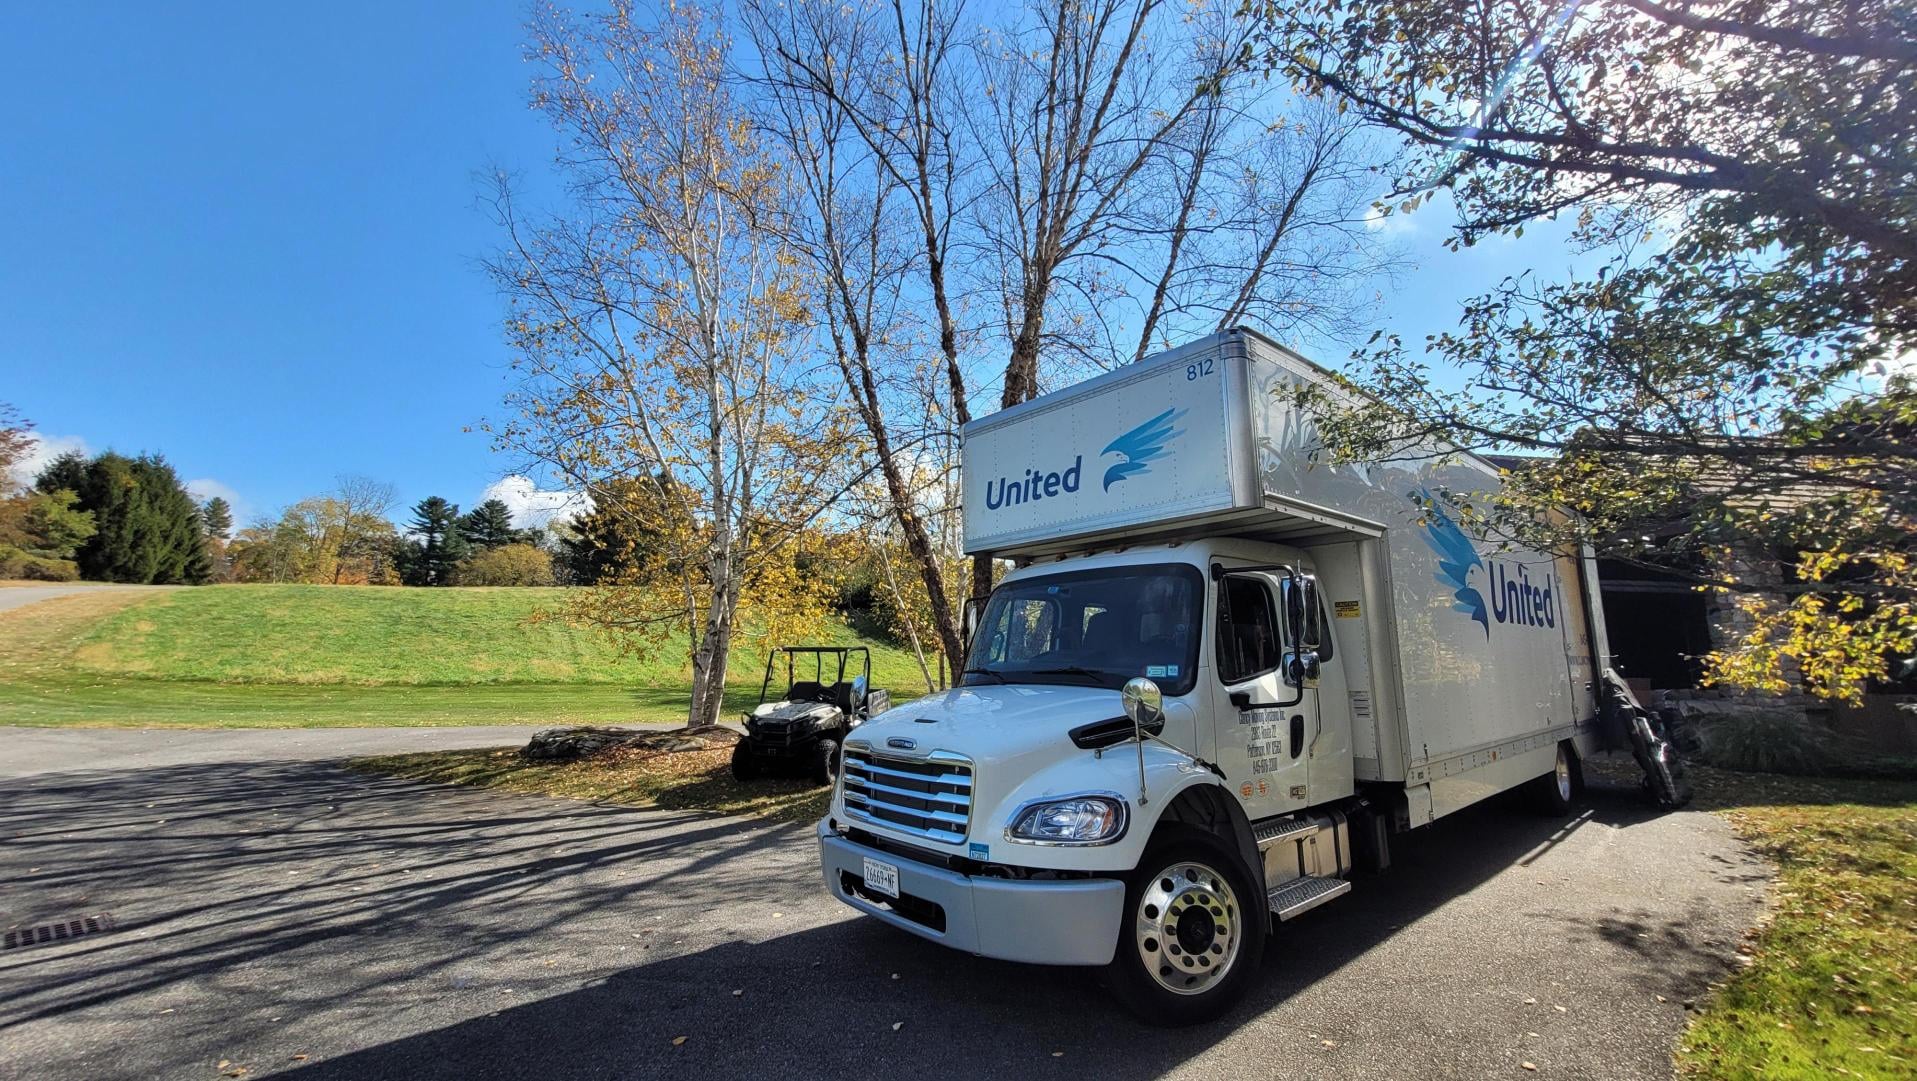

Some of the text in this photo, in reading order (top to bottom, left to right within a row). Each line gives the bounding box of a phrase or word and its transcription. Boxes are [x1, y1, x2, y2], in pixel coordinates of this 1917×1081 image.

[1185, 358, 1214, 382] 812
[985, 455, 1083, 510] United
[1488, 560, 1555, 629] United
